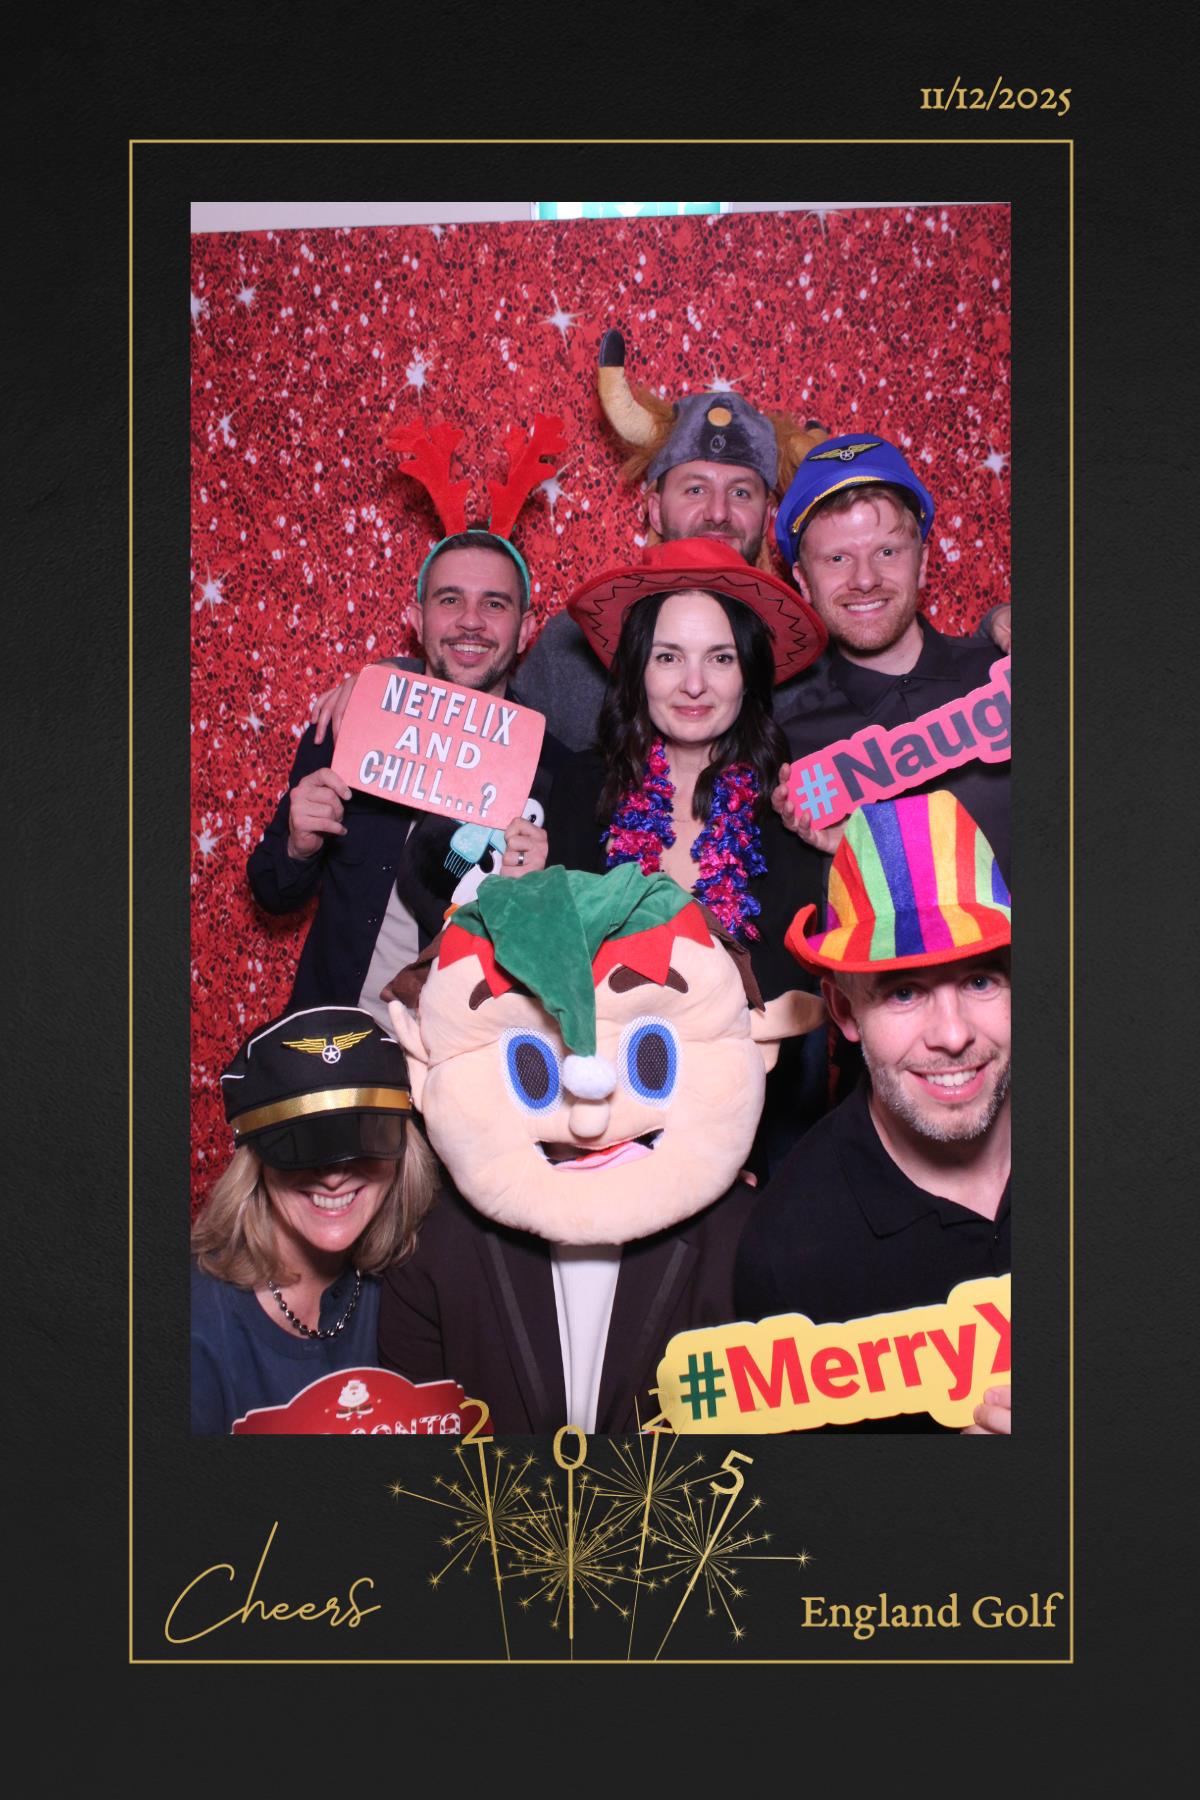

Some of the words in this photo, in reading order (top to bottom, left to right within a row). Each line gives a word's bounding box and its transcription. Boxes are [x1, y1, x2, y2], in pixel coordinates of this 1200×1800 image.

[381, 673, 518, 746] NETFLIX
[394, 725, 482, 770] AND
[795, 669, 1012, 821] #Naug
[358, 750, 498, 818] CHILL...?
